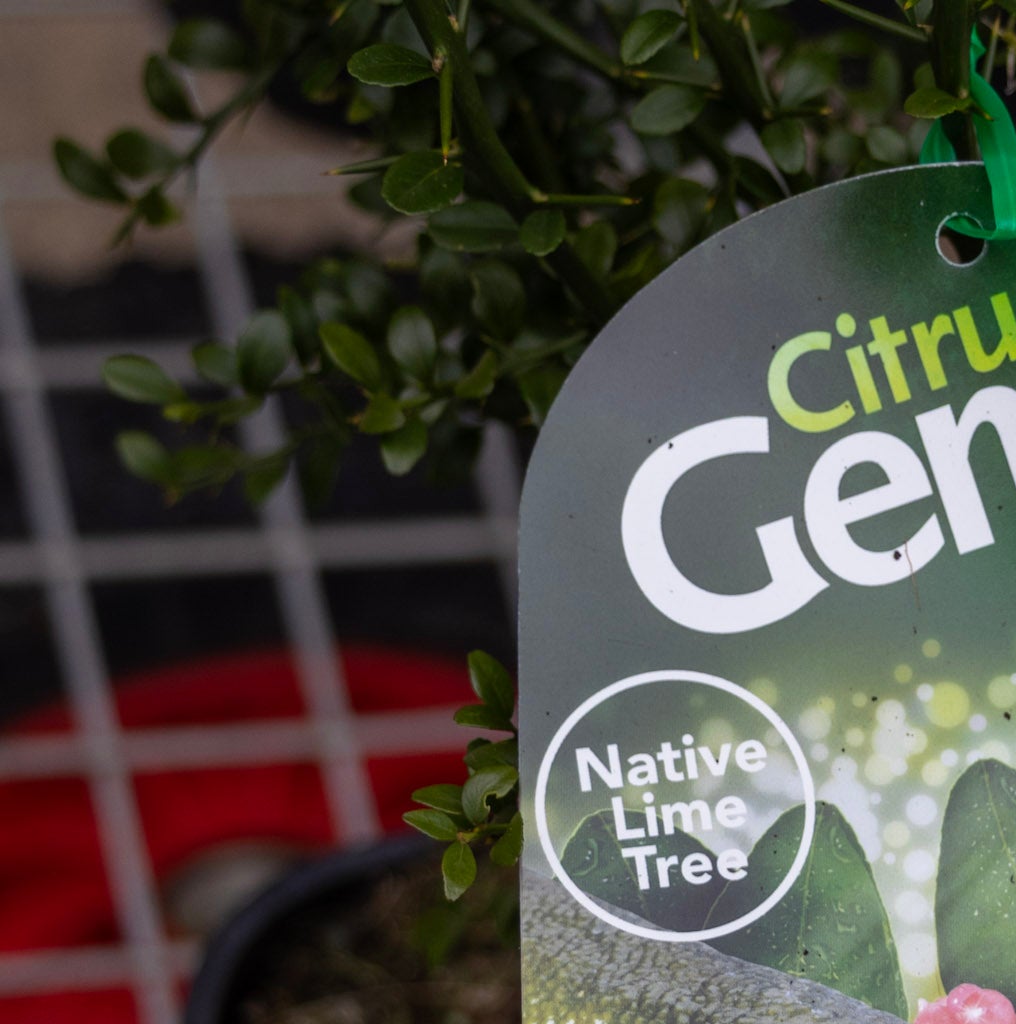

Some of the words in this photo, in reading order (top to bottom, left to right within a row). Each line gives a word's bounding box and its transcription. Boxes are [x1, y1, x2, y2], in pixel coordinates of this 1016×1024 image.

[575, 734, 768, 792] Native
[611, 791, 747, 840] Lime
[621, 845, 749, 890] Tree
